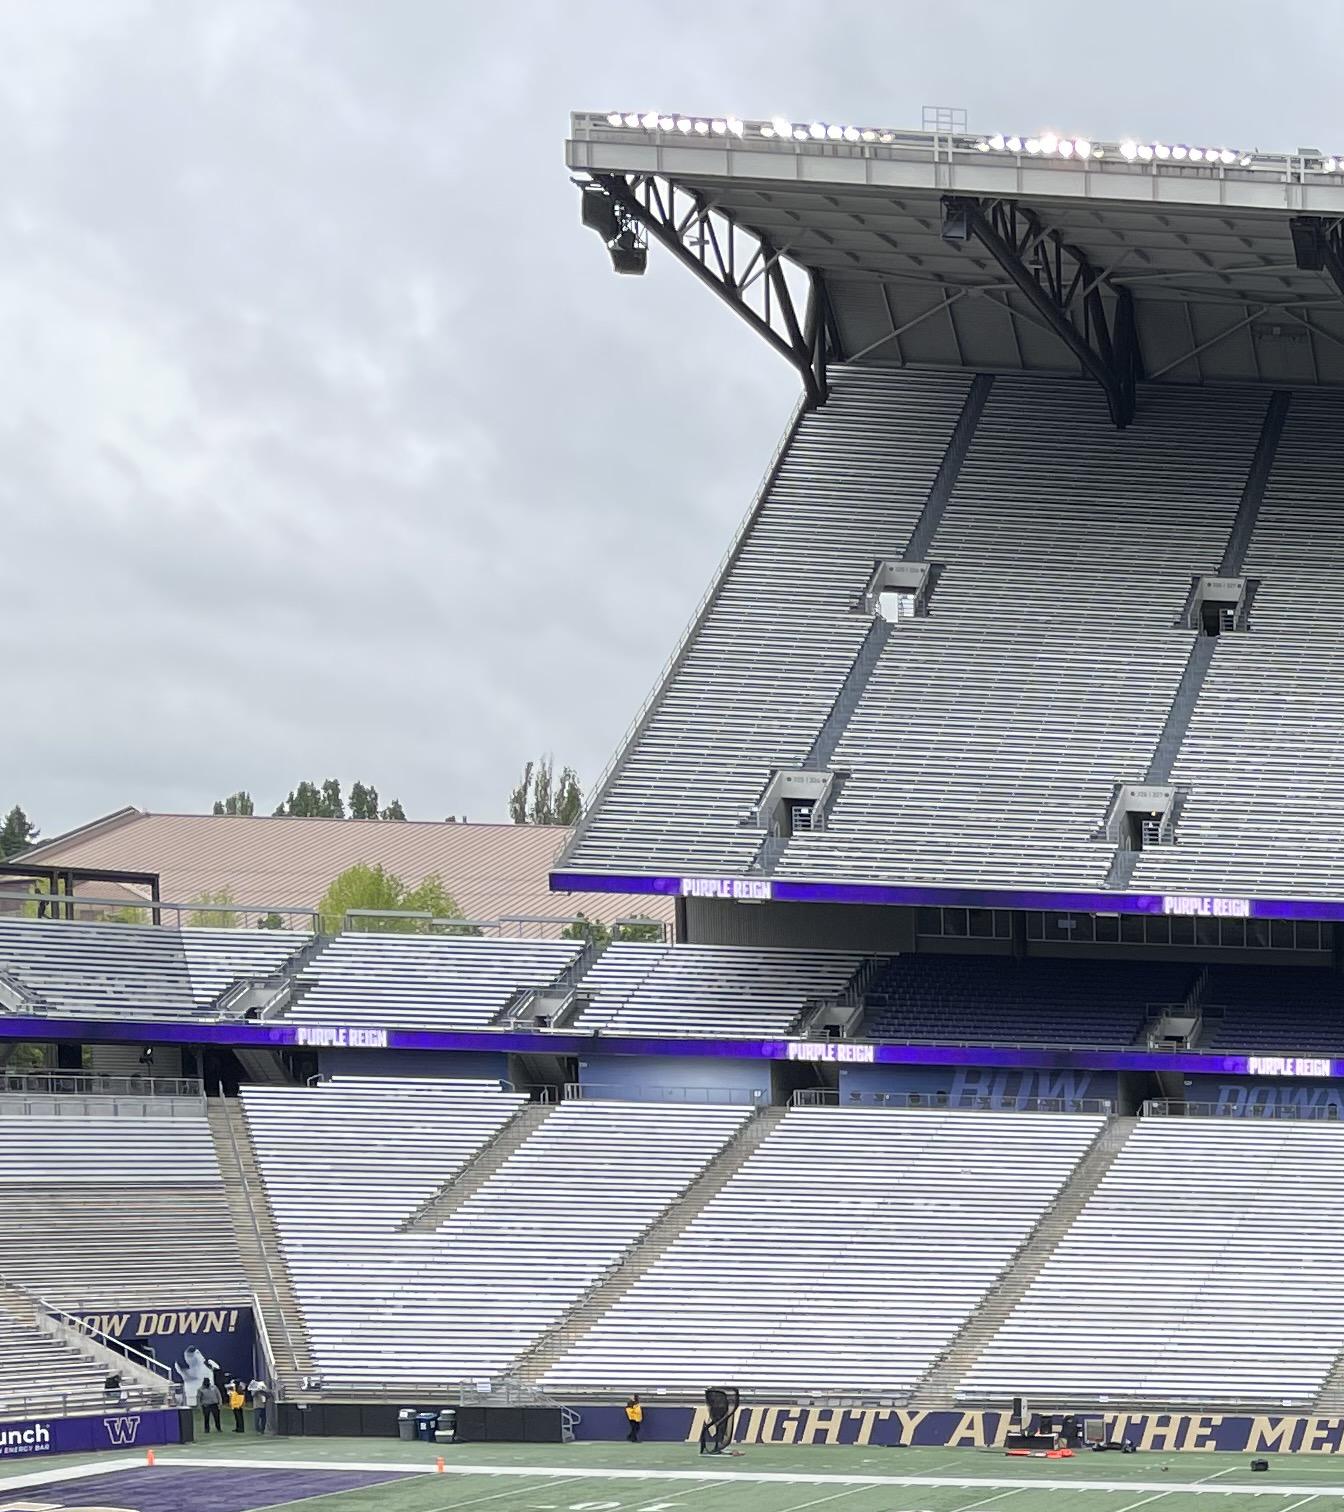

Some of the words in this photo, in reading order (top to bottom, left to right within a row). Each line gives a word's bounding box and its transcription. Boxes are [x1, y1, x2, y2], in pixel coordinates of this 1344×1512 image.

[682, 878, 731, 897] PURPLE
[733, 880, 772, 898] REIGN
[1164, 897, 1211, 915] PURPLE
[1213, 899, 1250, 916] REIGN
[297, 1028, 347, 1046] PURPLE
[349, 1029, 387, 1047] REIGN
[788, 1043, 835, 1060] PURPLE
[837, 1044, 874, 1061] REIGN
[1249, 1057, 1294, 1075] PURPLE
[1295, 1058, 1331, 1076] REIGN
[136, 1310, 238, 1336] DOWN!
[104, 1416, 140, 1445] W
[1104, 1413, 1224, 1453] THE
